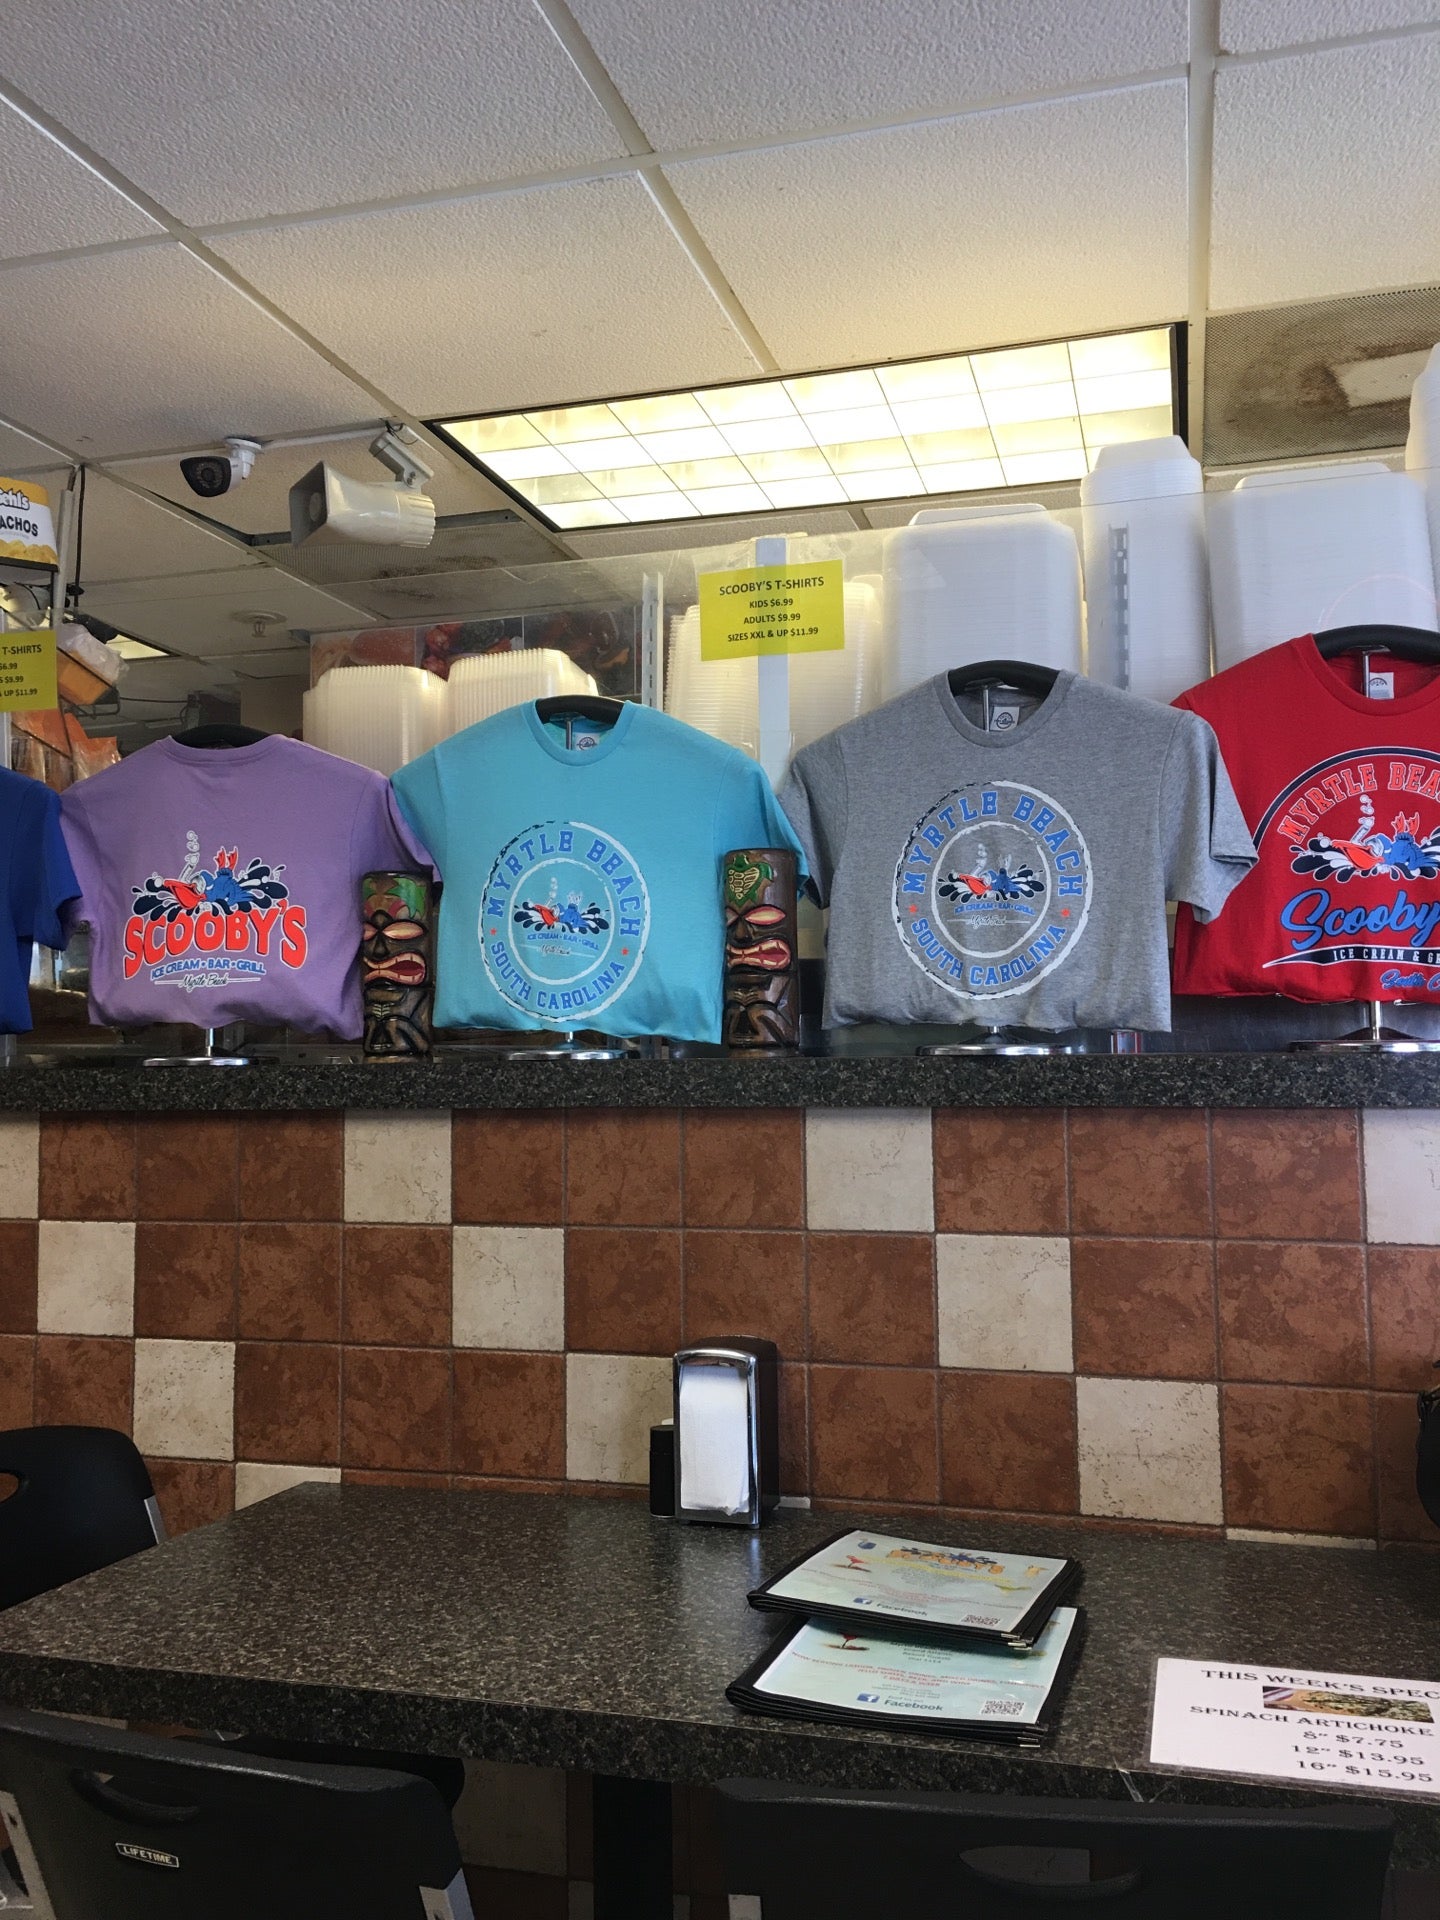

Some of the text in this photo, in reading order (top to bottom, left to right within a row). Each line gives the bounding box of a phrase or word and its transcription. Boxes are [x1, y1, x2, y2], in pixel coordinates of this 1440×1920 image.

[719, 576, 824, 596] SCOOBY'S T-SHIRTS
[749, 597, 794, 609] KIDS $6.99
[743, 612, 801, 625] ADULTS $9.99
[727, 626, 819, 642] SIZES XXL & UP $11.99
[2, 644, 42, 655] T-SHIRTS
[4, 675, 24, 684] $9.99
[4, 689, 14, 697] UP
[15, 687, 38, 697] $11.99
[1277, 761, 1440, 845] MYRTLE BEA
[901, 790, 1084, 897] MYRTLE BEACH
[486, 829, 642, 937] MYRTLE BEACH
[123, 898, 309, 980] SCOOBY'S
[911, 917, 1067, 986] SOUTH CAROLINA
[1333, 948, 1355, 962] ICE
[1363, 948, 1404, 961] CREAM
[1412, 950, 1420, 962] &
[150, 957, 266, 980] ICE CREAM BAR GRILL
[490, 940, 626, 1011] SOUTH CAROLINA
[178, 973, 229, 993] Myrtle Beach
[1201, 1669, 1258, 1682] THIS
[1266, 1674, 1365, 1692] WEEK'S
[884, 1699, 943, 1711] Facebook
[1190, 1706, 1435, 1737] SPINACH ARTICHOKE
[1335, 1734, 1404, 1749] $7.75
[1338, 1749, 1425, 1766] $13.95
[1345, 1765, 1433, 1783] $15.95
[123, 1845, 172, 1864] LIFETIME
